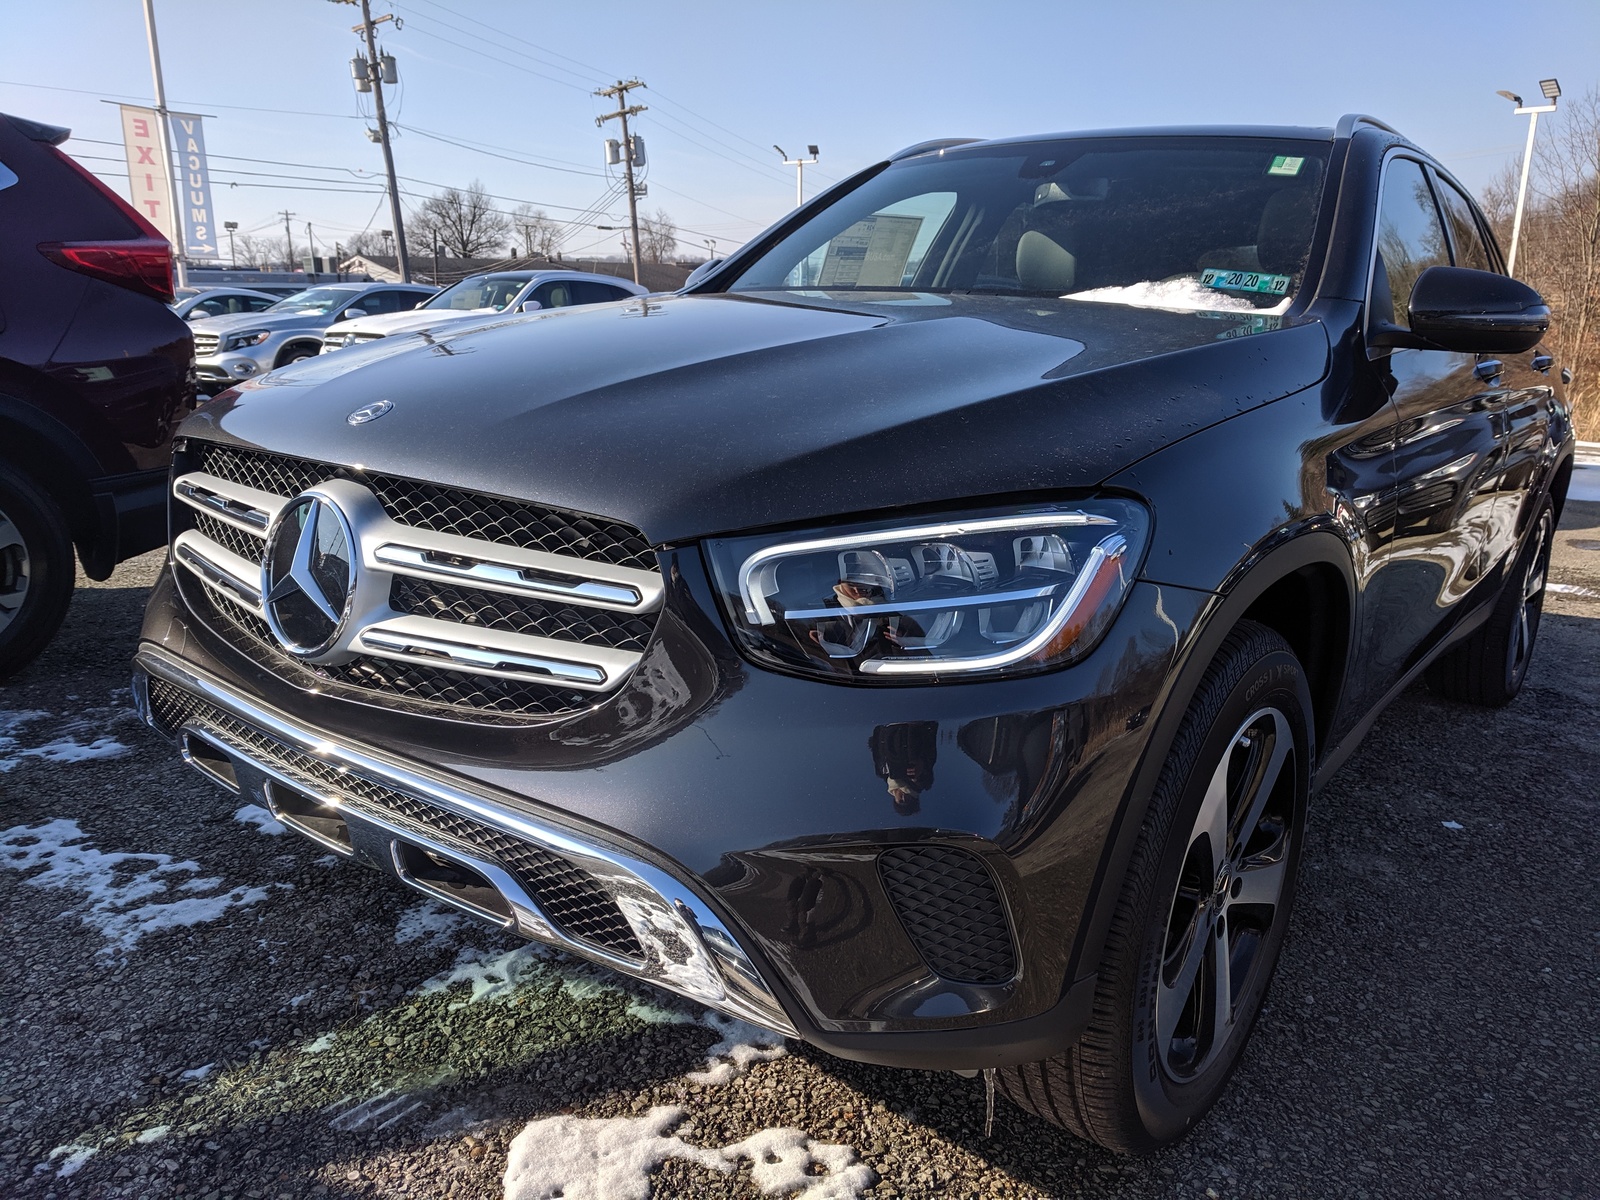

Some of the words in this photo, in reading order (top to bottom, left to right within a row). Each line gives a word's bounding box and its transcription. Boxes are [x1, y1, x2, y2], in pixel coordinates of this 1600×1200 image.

[1202, 273, 1214, 284] 12
[1228, 272, 1243, 285] 20
[1244, 274, 1259, 287] 20
[1274, 280, 1286, 291] 12
[1245, 671, 1268, 702] CROSS
